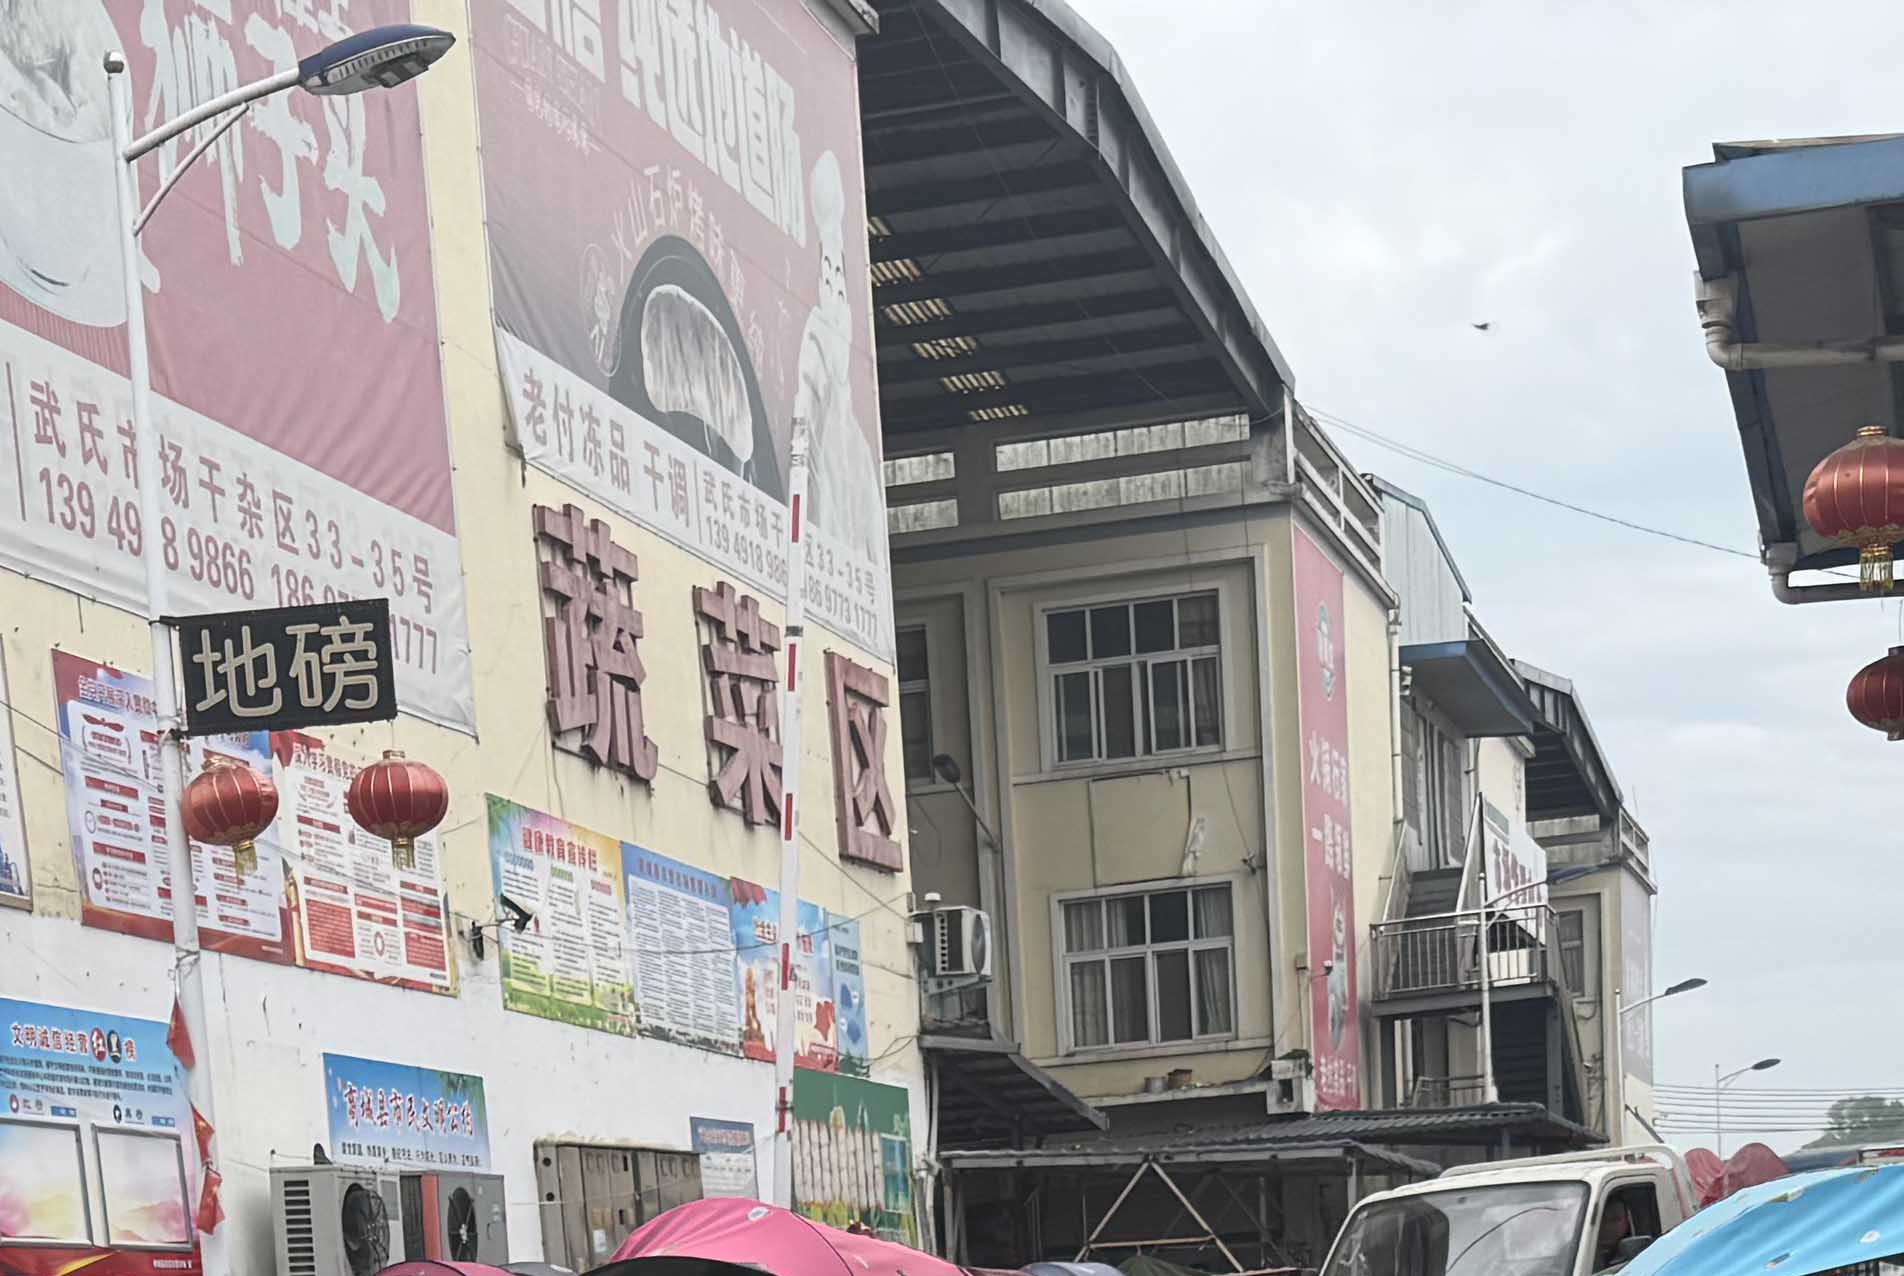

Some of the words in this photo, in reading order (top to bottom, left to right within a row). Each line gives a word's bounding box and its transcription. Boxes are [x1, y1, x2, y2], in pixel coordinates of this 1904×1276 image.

[523, 369, 630, 497] 老付冻品
[644, 450, 692, 529] 干调
[39, 469, 98, 540] 139
[107, 485, 178, 571] 498
[189, 528, 254, 601] 9866
[703, 469, 878, 605] 武氏市场干区33-35号
[705, 517, 730, 555] 139
[734, 533, 765, 573] 4918
[767, 549, 788, 589] 986
[825, 587, 852, 623] 9773
[855, 603, 879, 643] 1777
[194, 615, 379, 718] 地磅
[533, 503, 904, 874] 蔬菜区
